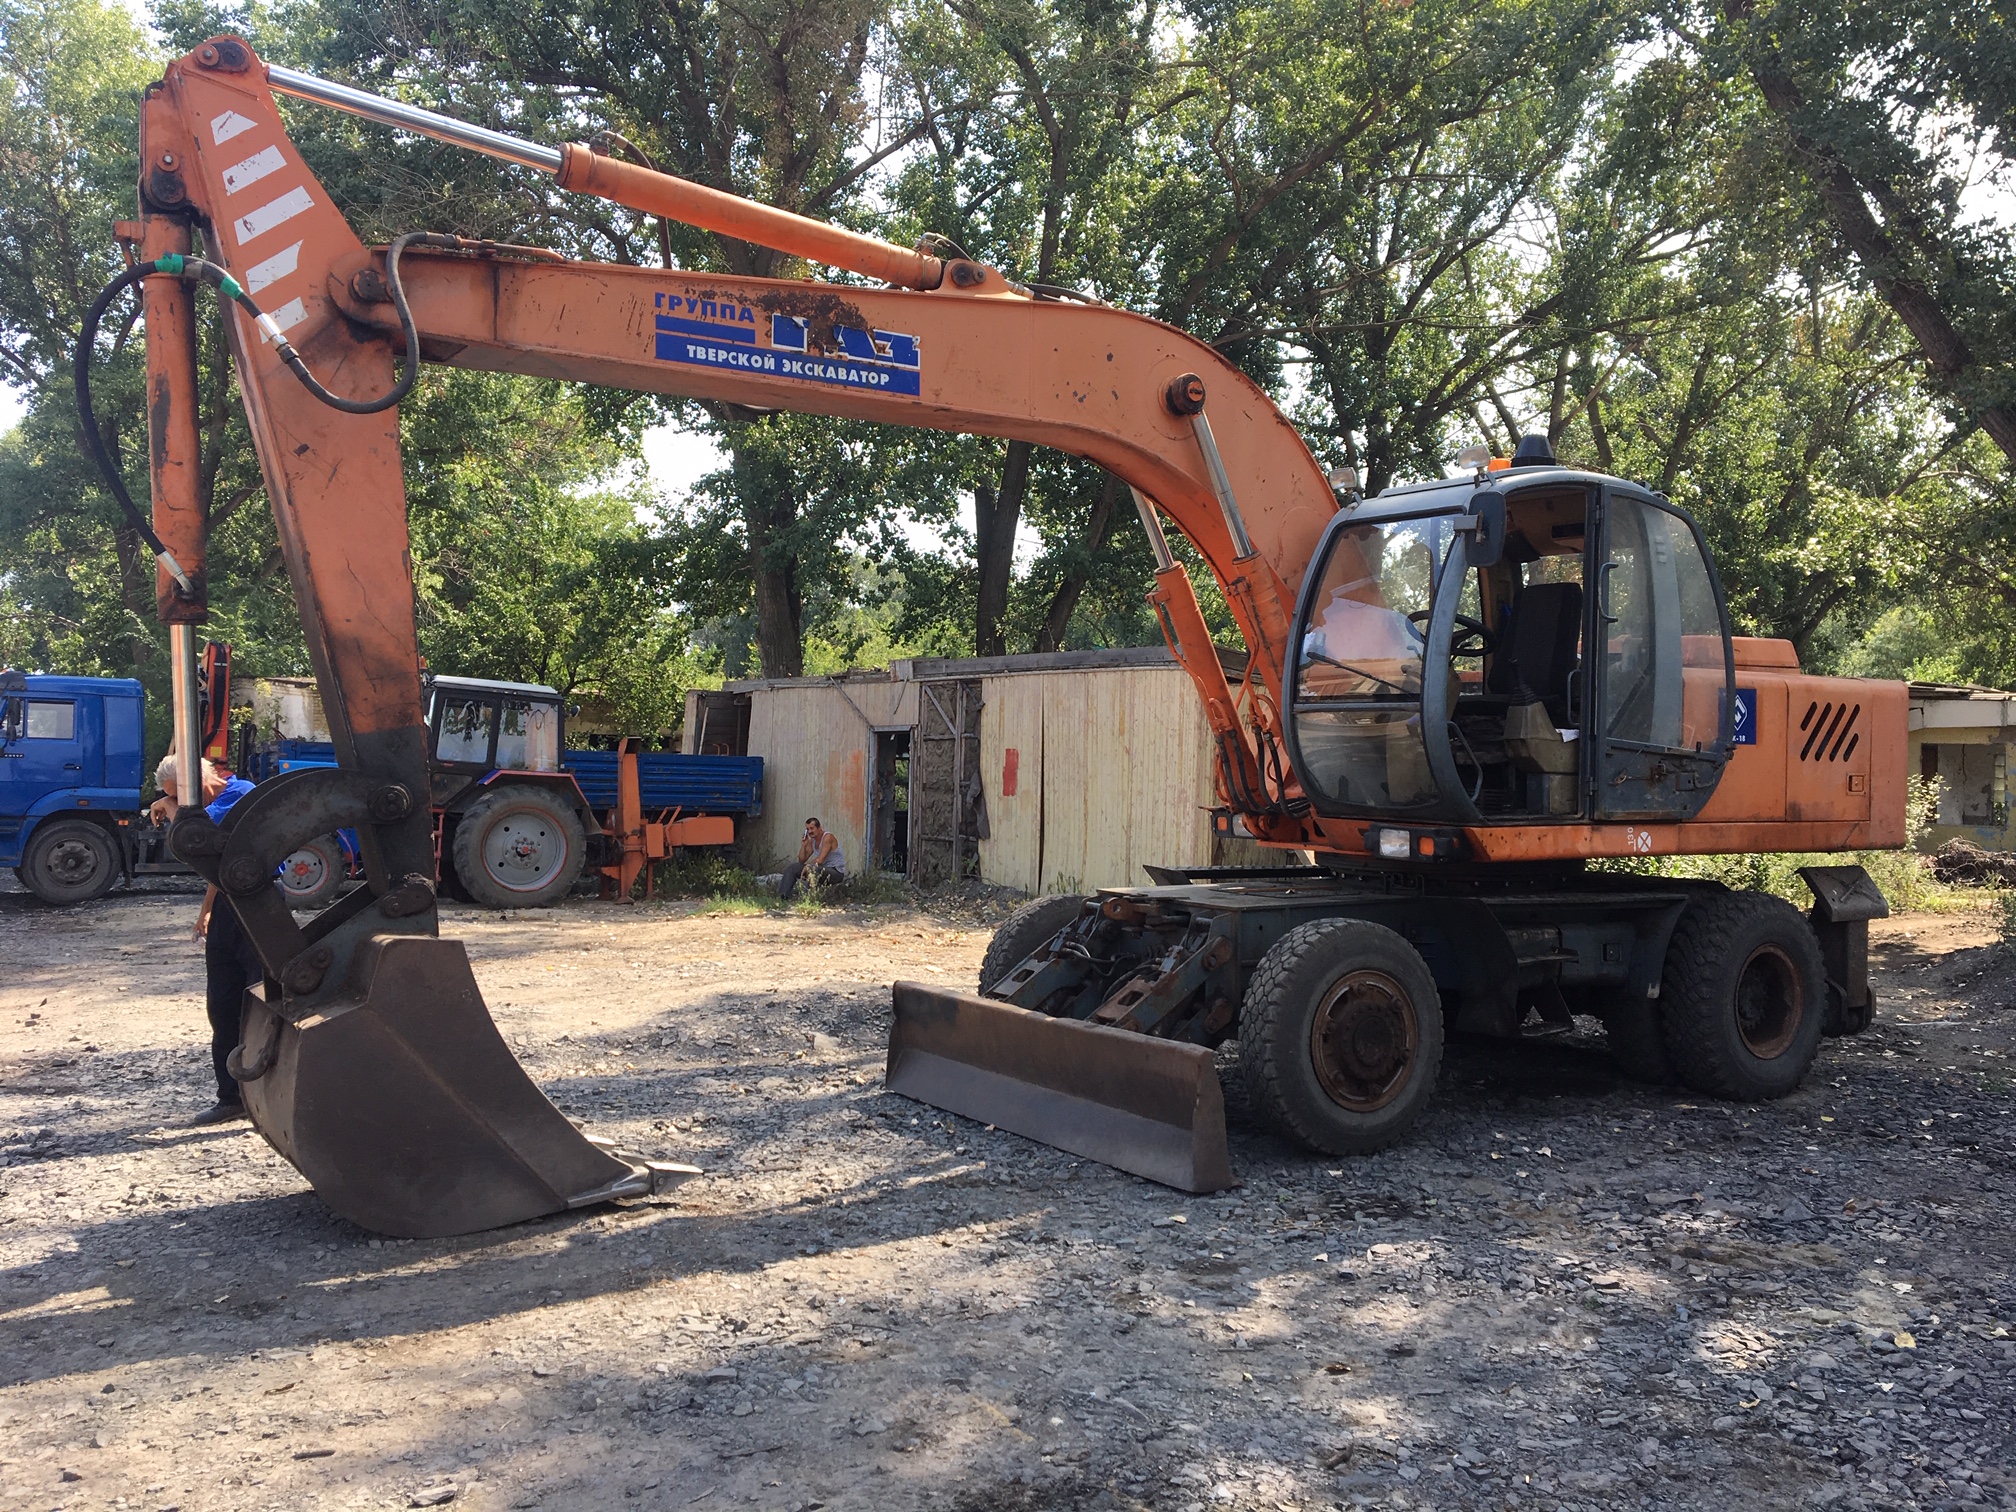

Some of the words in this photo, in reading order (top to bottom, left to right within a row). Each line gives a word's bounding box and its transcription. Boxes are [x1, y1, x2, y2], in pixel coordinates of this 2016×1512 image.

[655, 292, 755, 323] ГРУППА
[687, 344, 775, 370] ТВЕРСКОЙ
[782, 359, 890, 385] ЭКСКАВАТОР
